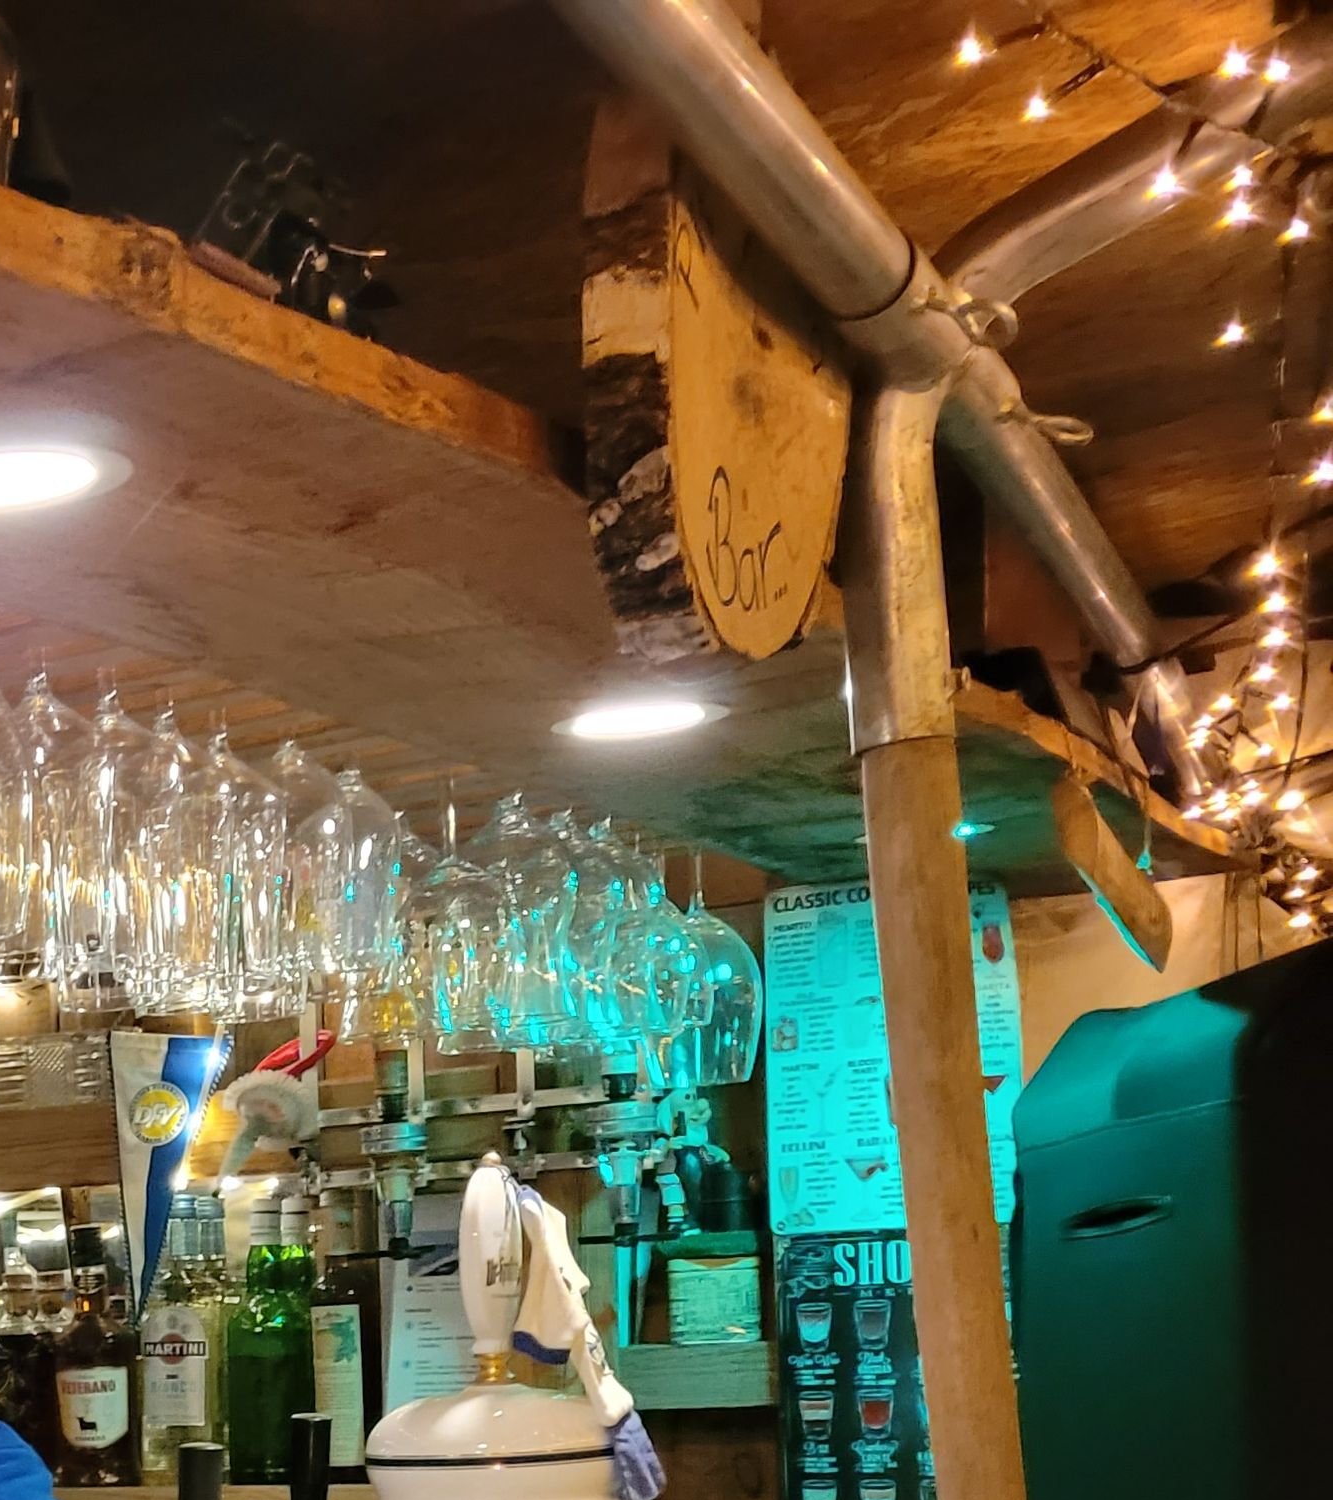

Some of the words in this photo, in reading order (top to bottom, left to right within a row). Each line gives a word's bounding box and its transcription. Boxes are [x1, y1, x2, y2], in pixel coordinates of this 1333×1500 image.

[772, 889, 844, 913] CLASSIC
[833, 1240, 913, 1286] SHO
[145, 1342, 206, 1356] MARTINI
